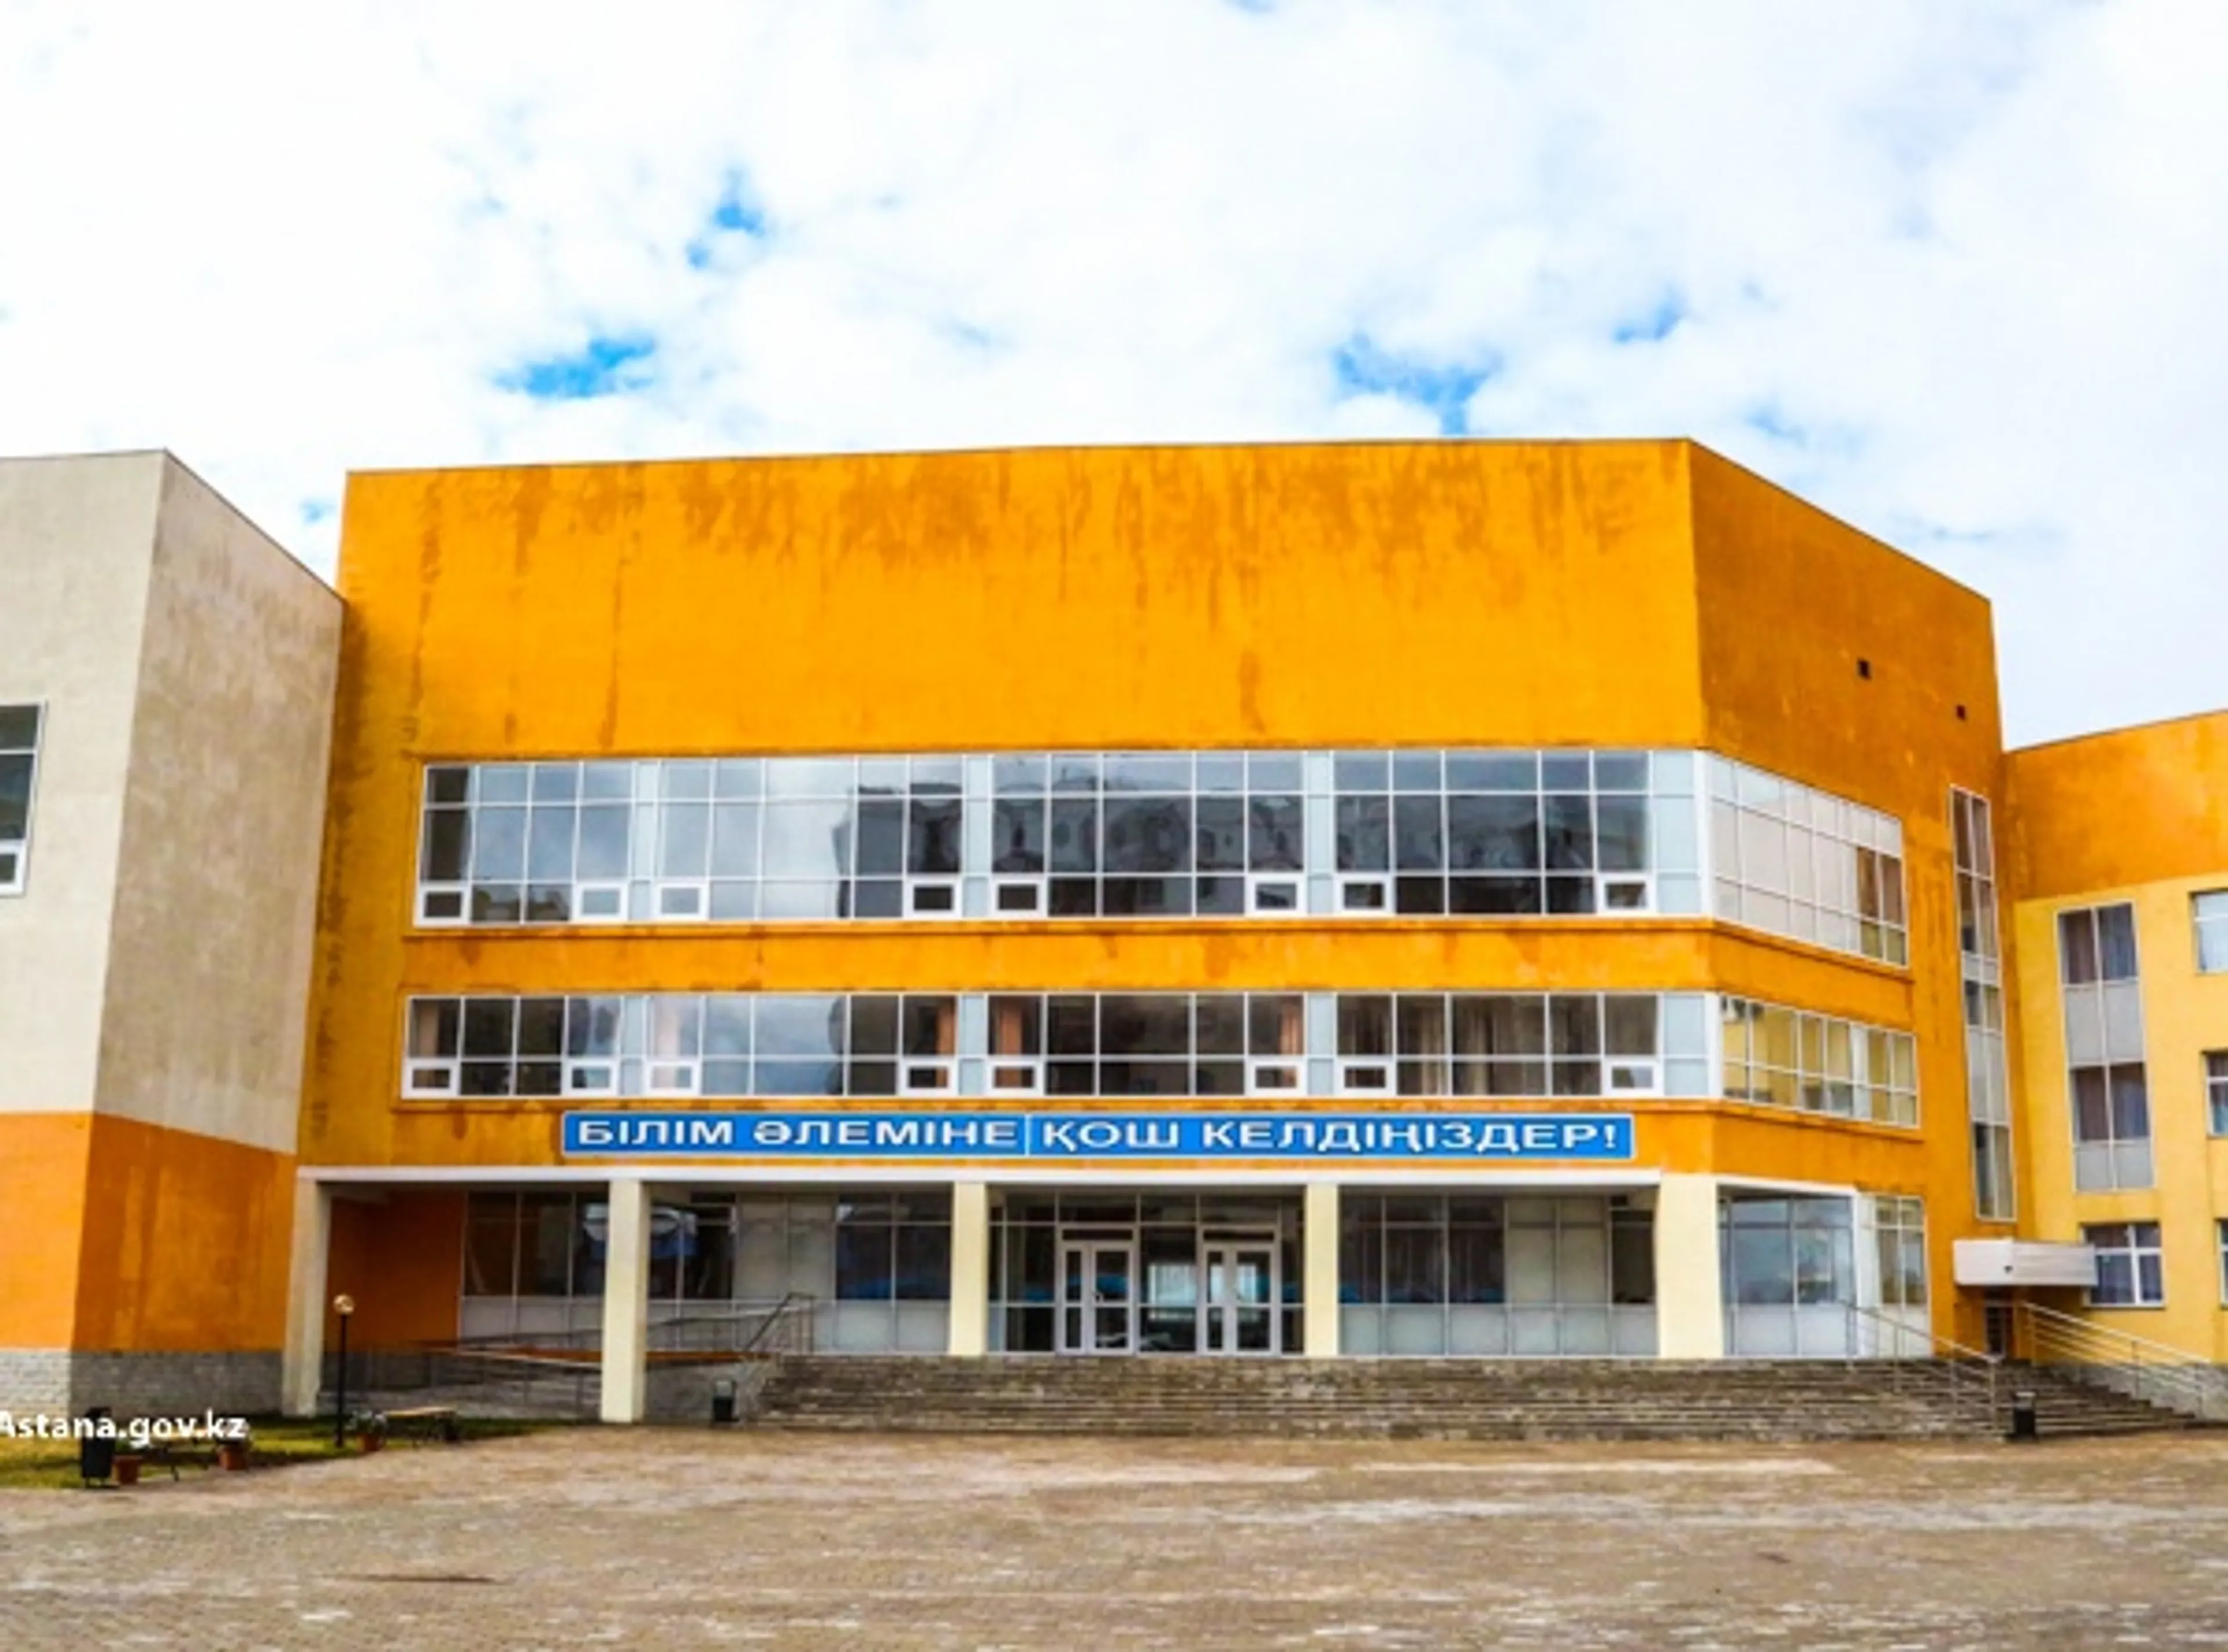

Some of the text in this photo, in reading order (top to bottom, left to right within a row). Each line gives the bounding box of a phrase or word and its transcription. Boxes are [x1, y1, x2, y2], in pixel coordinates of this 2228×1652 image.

[578, 1119, 1618, 1153] БІЛІМ ӘЛЕМІНЕ ҚОШ КЕЛДІҢІЗДЕР!
